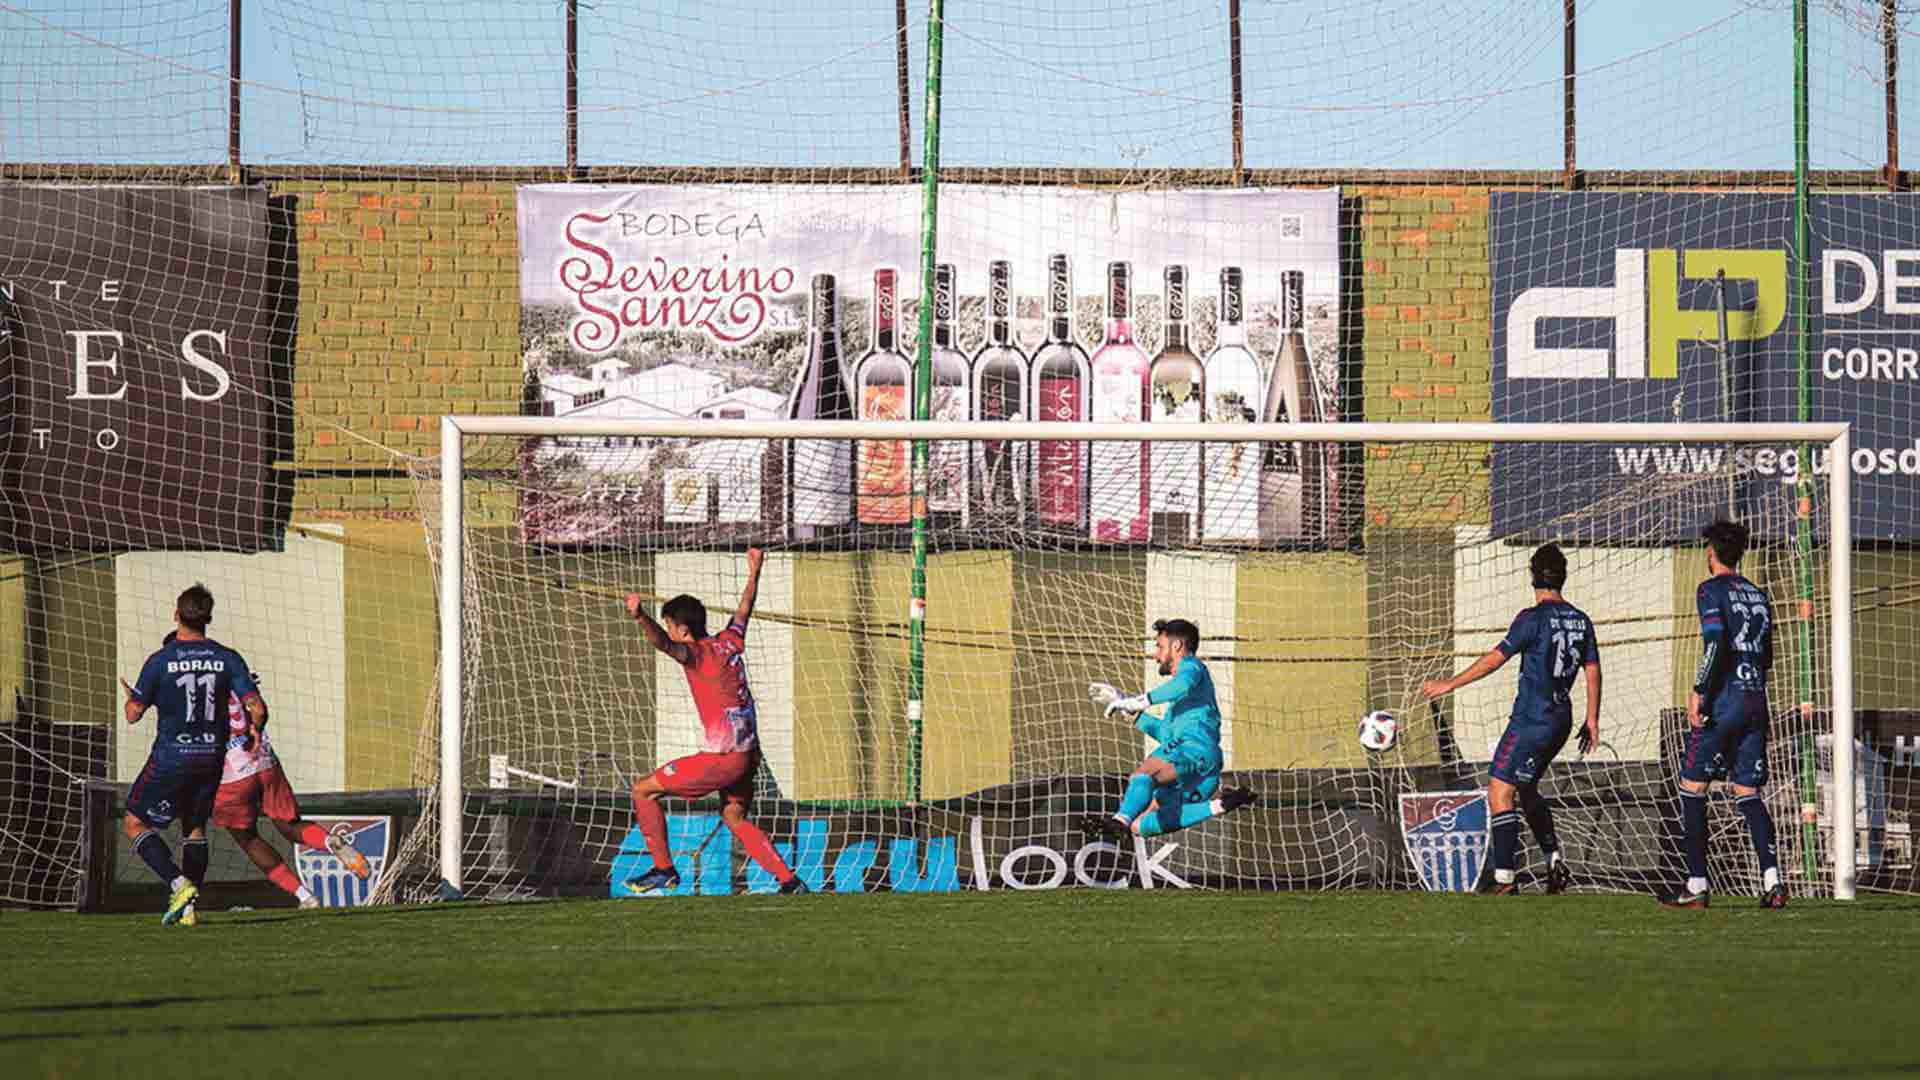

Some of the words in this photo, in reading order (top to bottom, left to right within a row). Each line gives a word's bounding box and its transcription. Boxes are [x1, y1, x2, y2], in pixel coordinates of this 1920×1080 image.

[617, 212, 767, 242] BODEGA
[559, 212, 794, 293] Severino
[573, 281, 765, 352] Sanz
[0, 328, 230, 401] ES
[1823, 348, 1919, 380] CORR
[1731, 603, 1769, 652] 22
[1552, 630, 1584, 678] 15
[176, 673, 216, 723] 11
